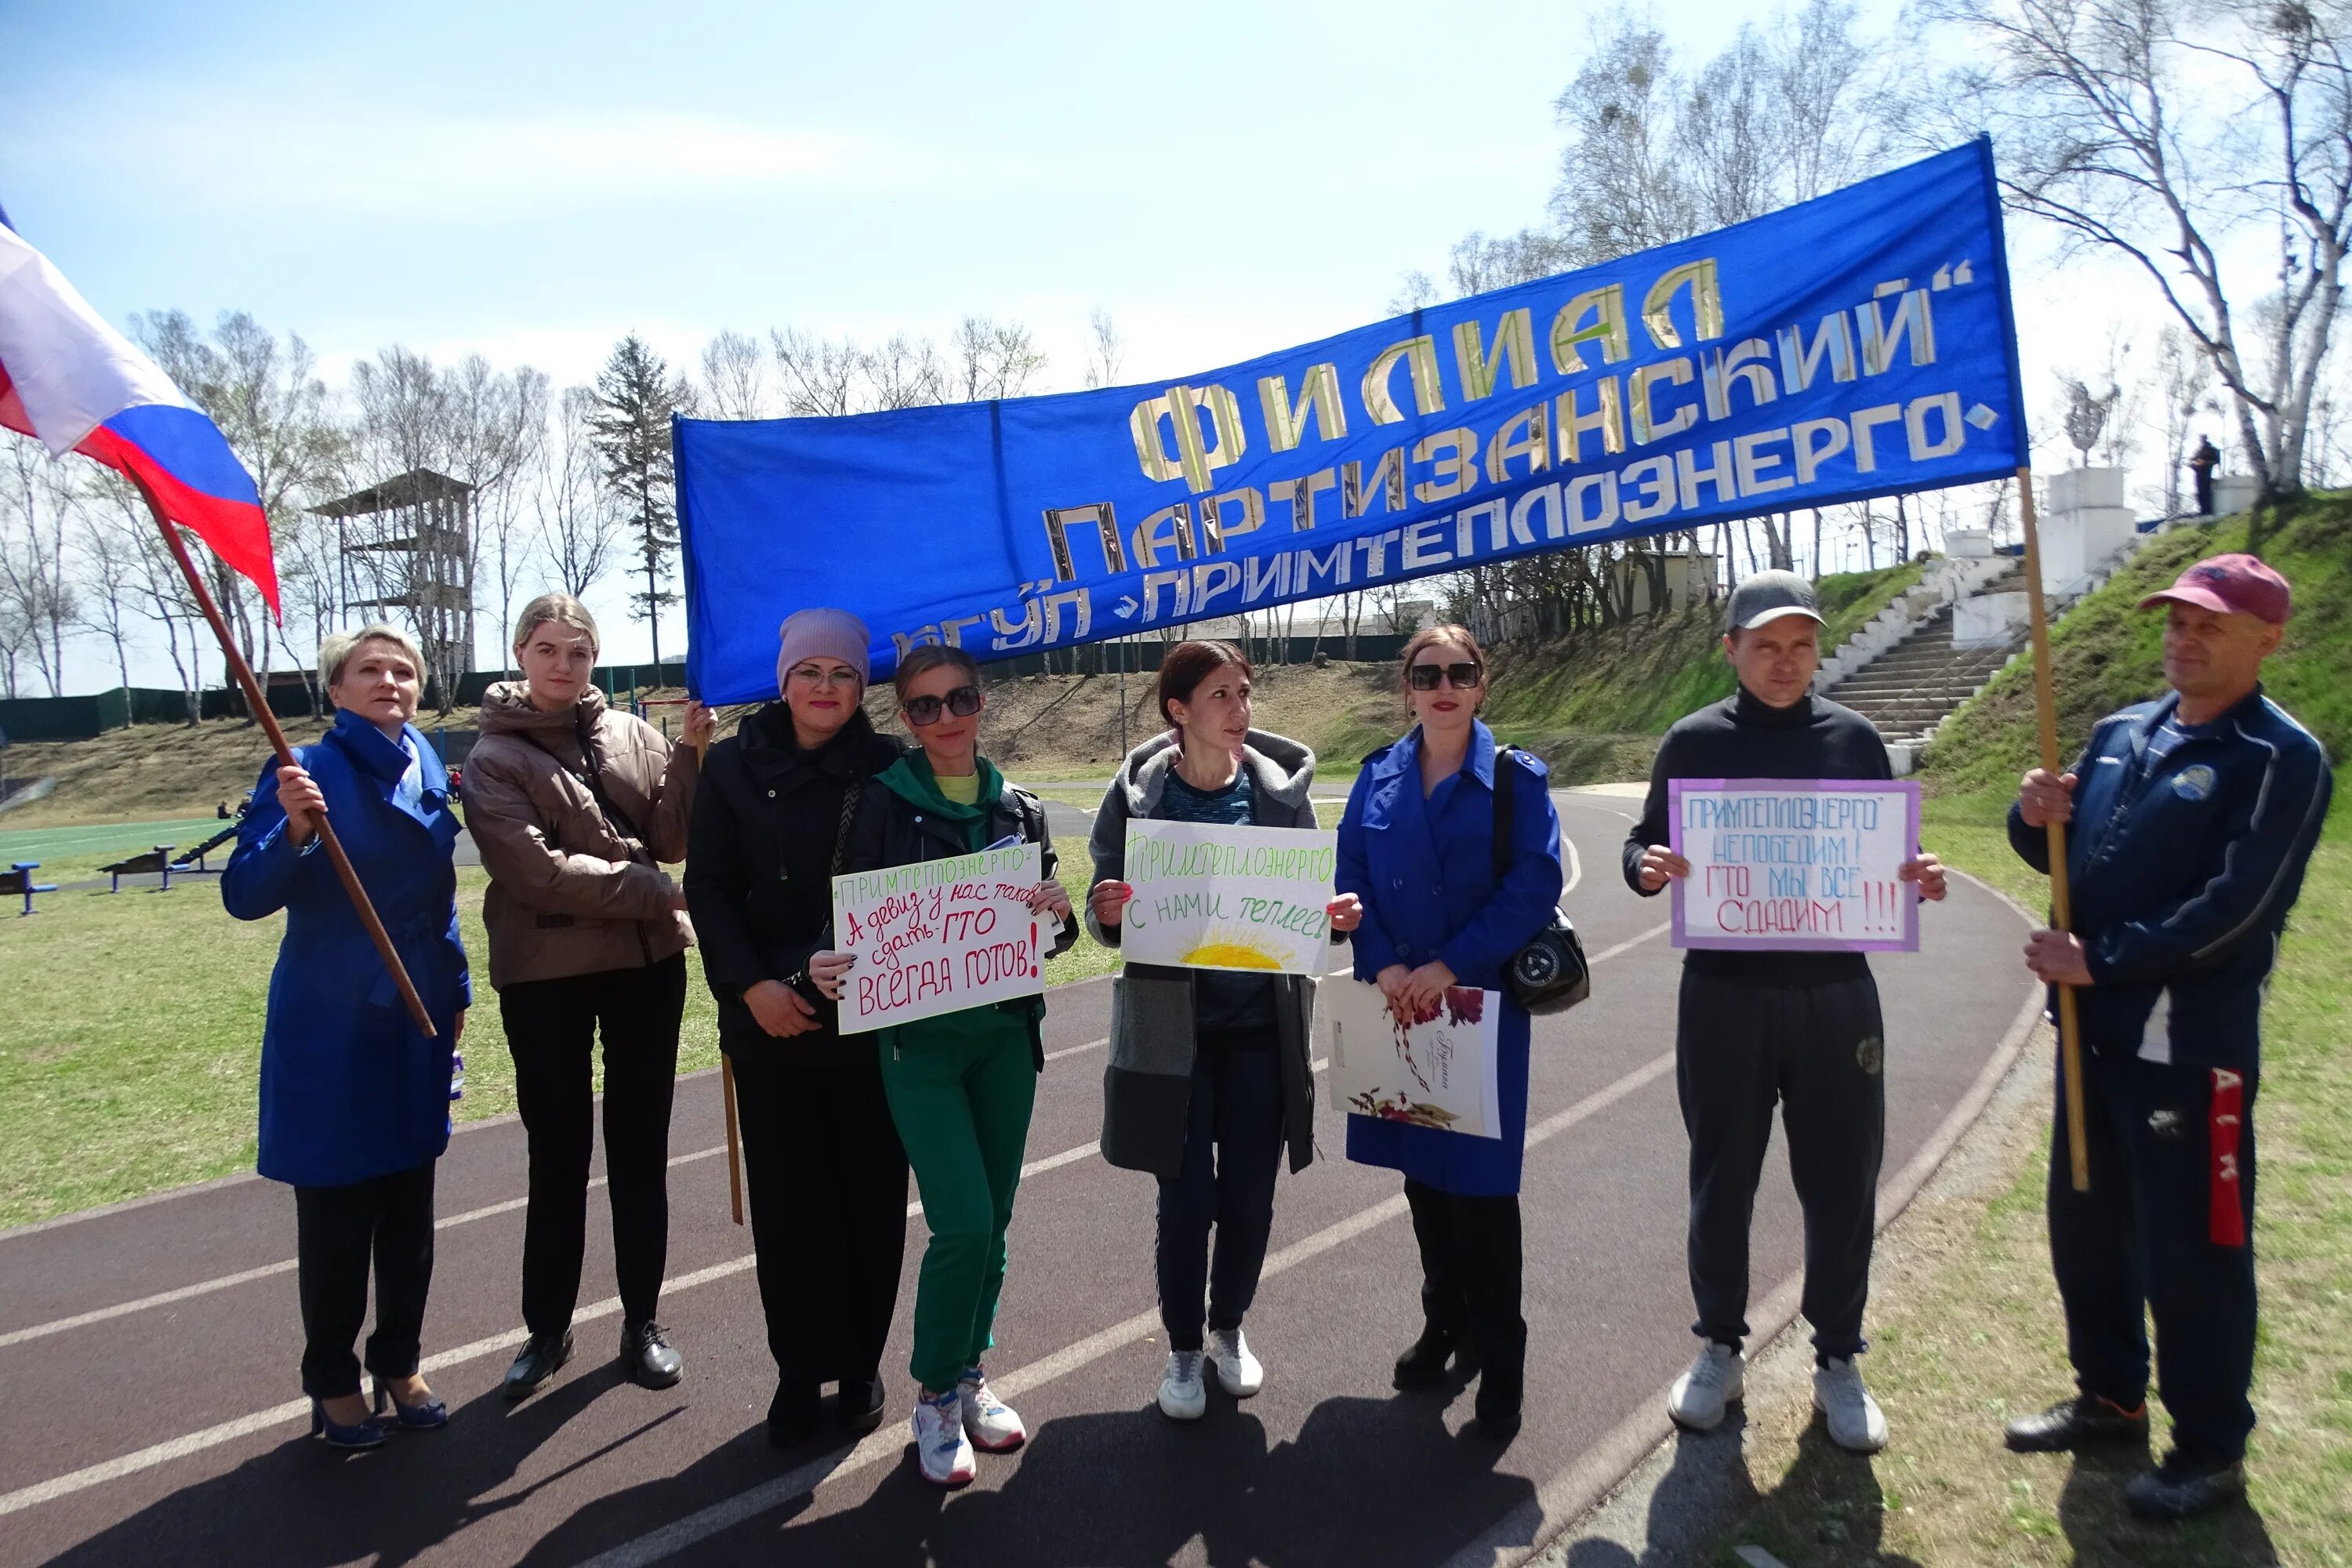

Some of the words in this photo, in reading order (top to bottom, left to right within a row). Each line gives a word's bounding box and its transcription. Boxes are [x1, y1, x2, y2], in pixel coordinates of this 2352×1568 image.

[1130, 257, 1723, 494] ФИЛИАЛ
[1706, 866, 1750, 897] ГТО
[1769, 866, 1806, 898] МЫ
[1820, 866, 1861, 898] ВСЕ
[847, 912, 864, 946] А
[868, 892, 924, 942] девиз
[928, 886, 943, 920] у
[950, 884, 988, 902] нас
